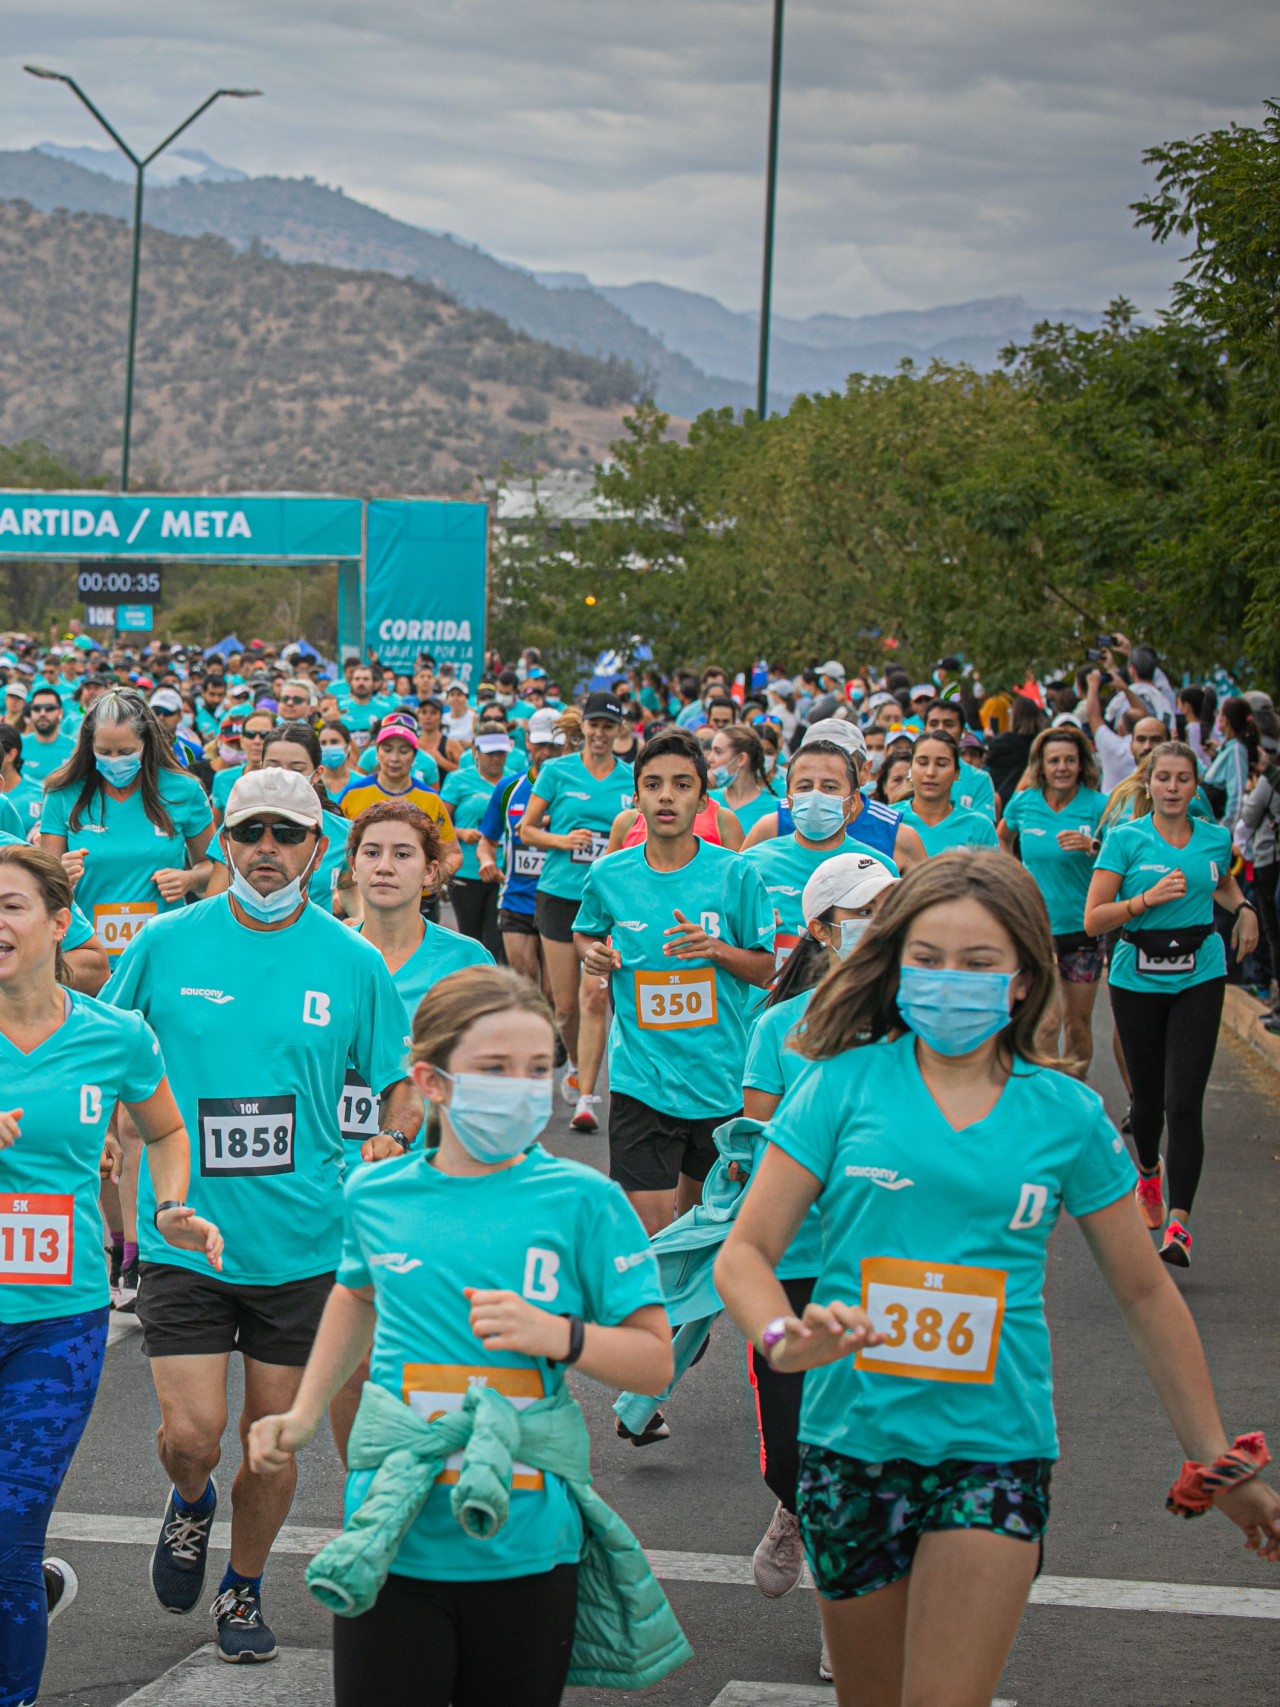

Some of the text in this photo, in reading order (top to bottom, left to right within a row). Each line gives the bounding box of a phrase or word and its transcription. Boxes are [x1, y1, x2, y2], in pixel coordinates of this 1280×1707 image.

[161, 510, 252, 538] META
[78, 572, 160, 592] 00:00:35
[88, 606, 115, 626] 10K
[379, 618, 471, 642] CORRIDA
[518, 856, 546, 870] 167
[669, 975, 680, 984] 3K
[180, 987, 224, 999] saucony
[650, 991, 702, 1017] 350
[239, 1103, 260, 1115] 10K
[211, 1125, 289, 1159] 1858
[844, 1165, 899, 1181] saucony
[12, 1200, 28, 1212] 5K
[923, 1272, 945, 1290] 3K
[883, 1303, 974, 1356] 386
